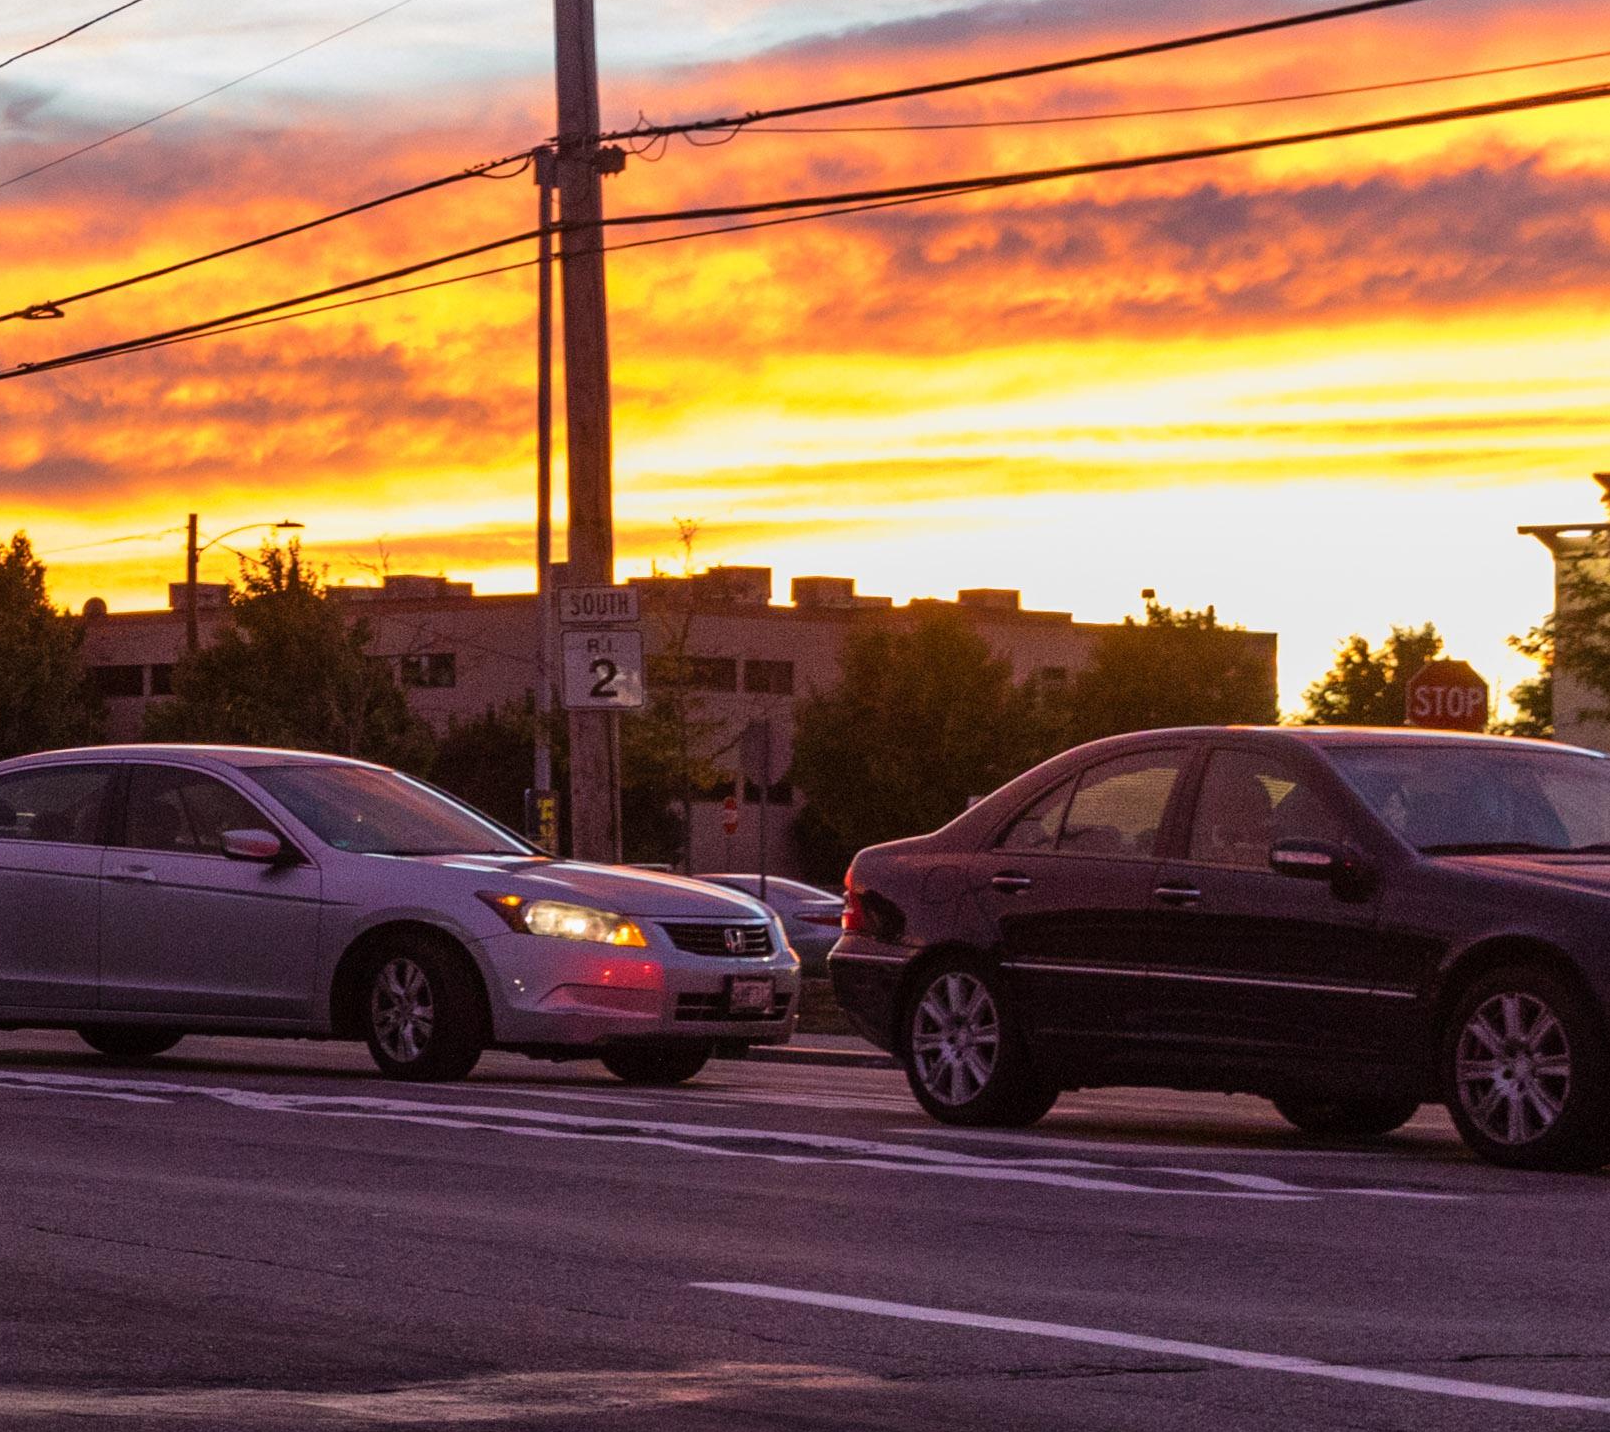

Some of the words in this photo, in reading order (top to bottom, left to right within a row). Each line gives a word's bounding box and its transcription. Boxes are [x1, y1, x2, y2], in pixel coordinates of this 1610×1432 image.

[571, 593, 629, 615] SOUTH
[590, 658, 618, 698] 2
[1415, 685, 1484, 716] STOP
